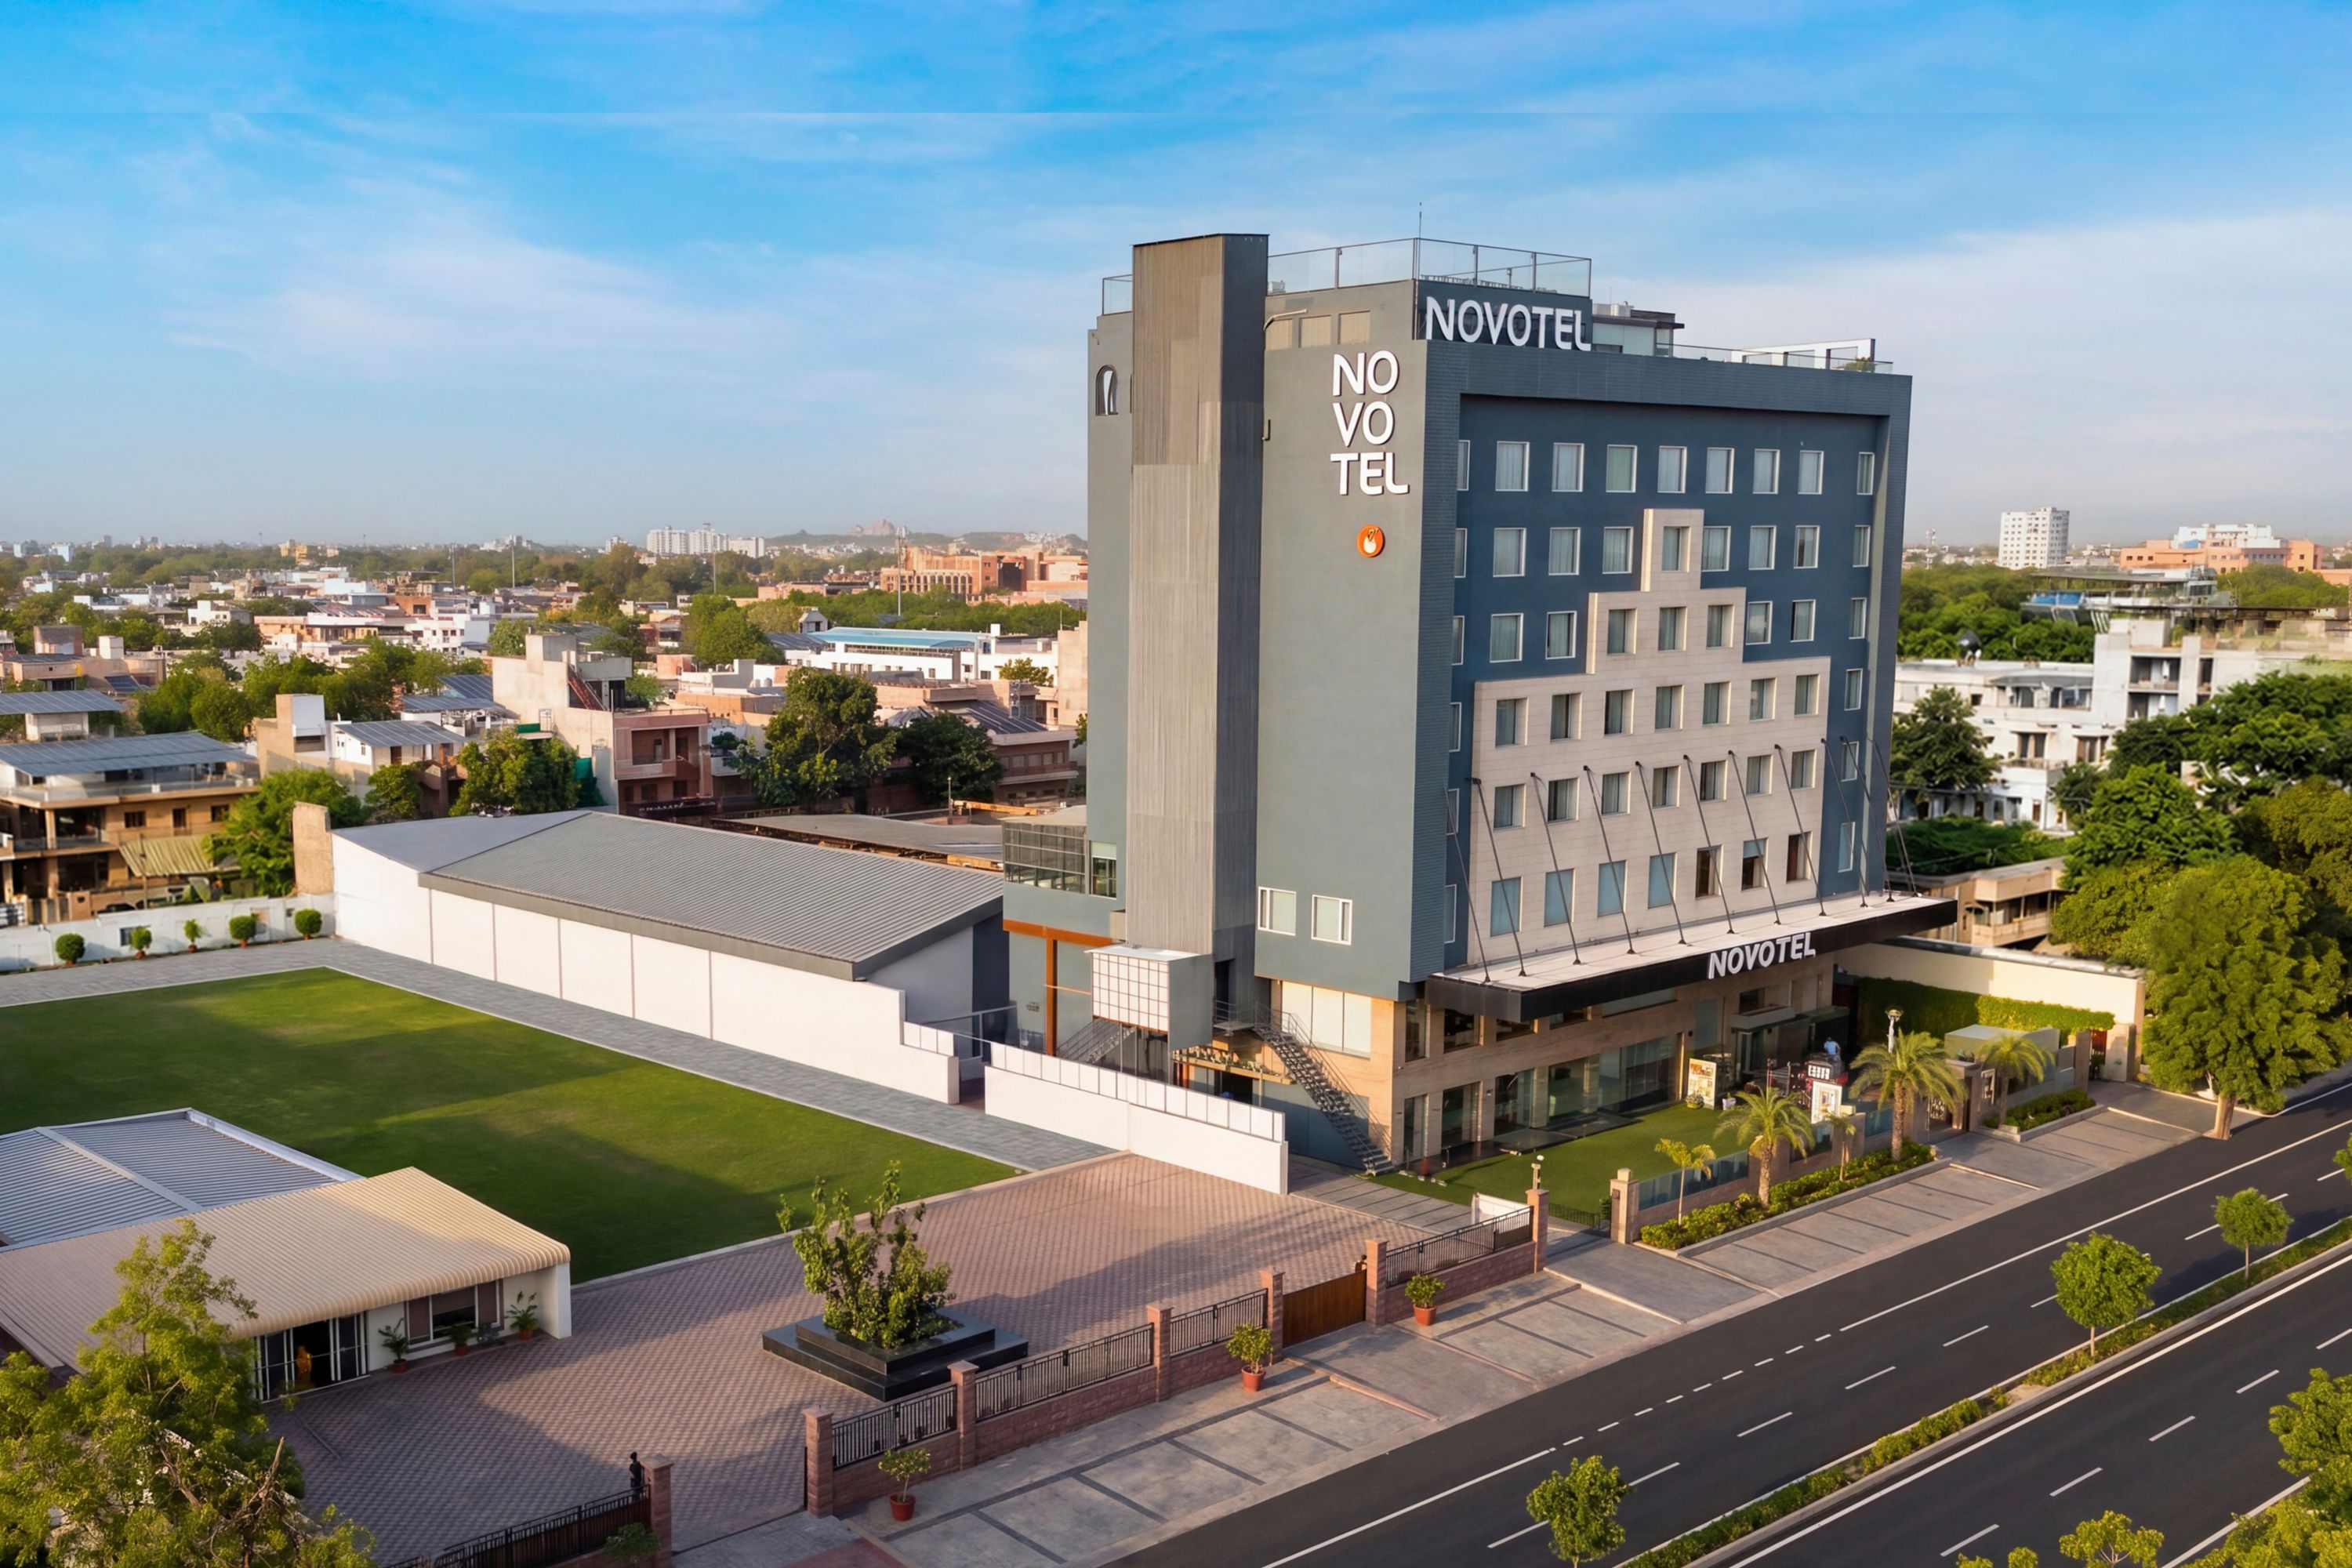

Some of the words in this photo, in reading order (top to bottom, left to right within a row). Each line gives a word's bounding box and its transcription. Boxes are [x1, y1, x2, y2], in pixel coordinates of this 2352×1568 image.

[1425, 296, 1592, 351] NOVOTEL
[1333, 350, 1399, 397] NO
[1333, 401, 1395, 448] VO
[1330, 452, 1410, 495] TEL
[1708, 932, 1816, 980] NOVOTEL
